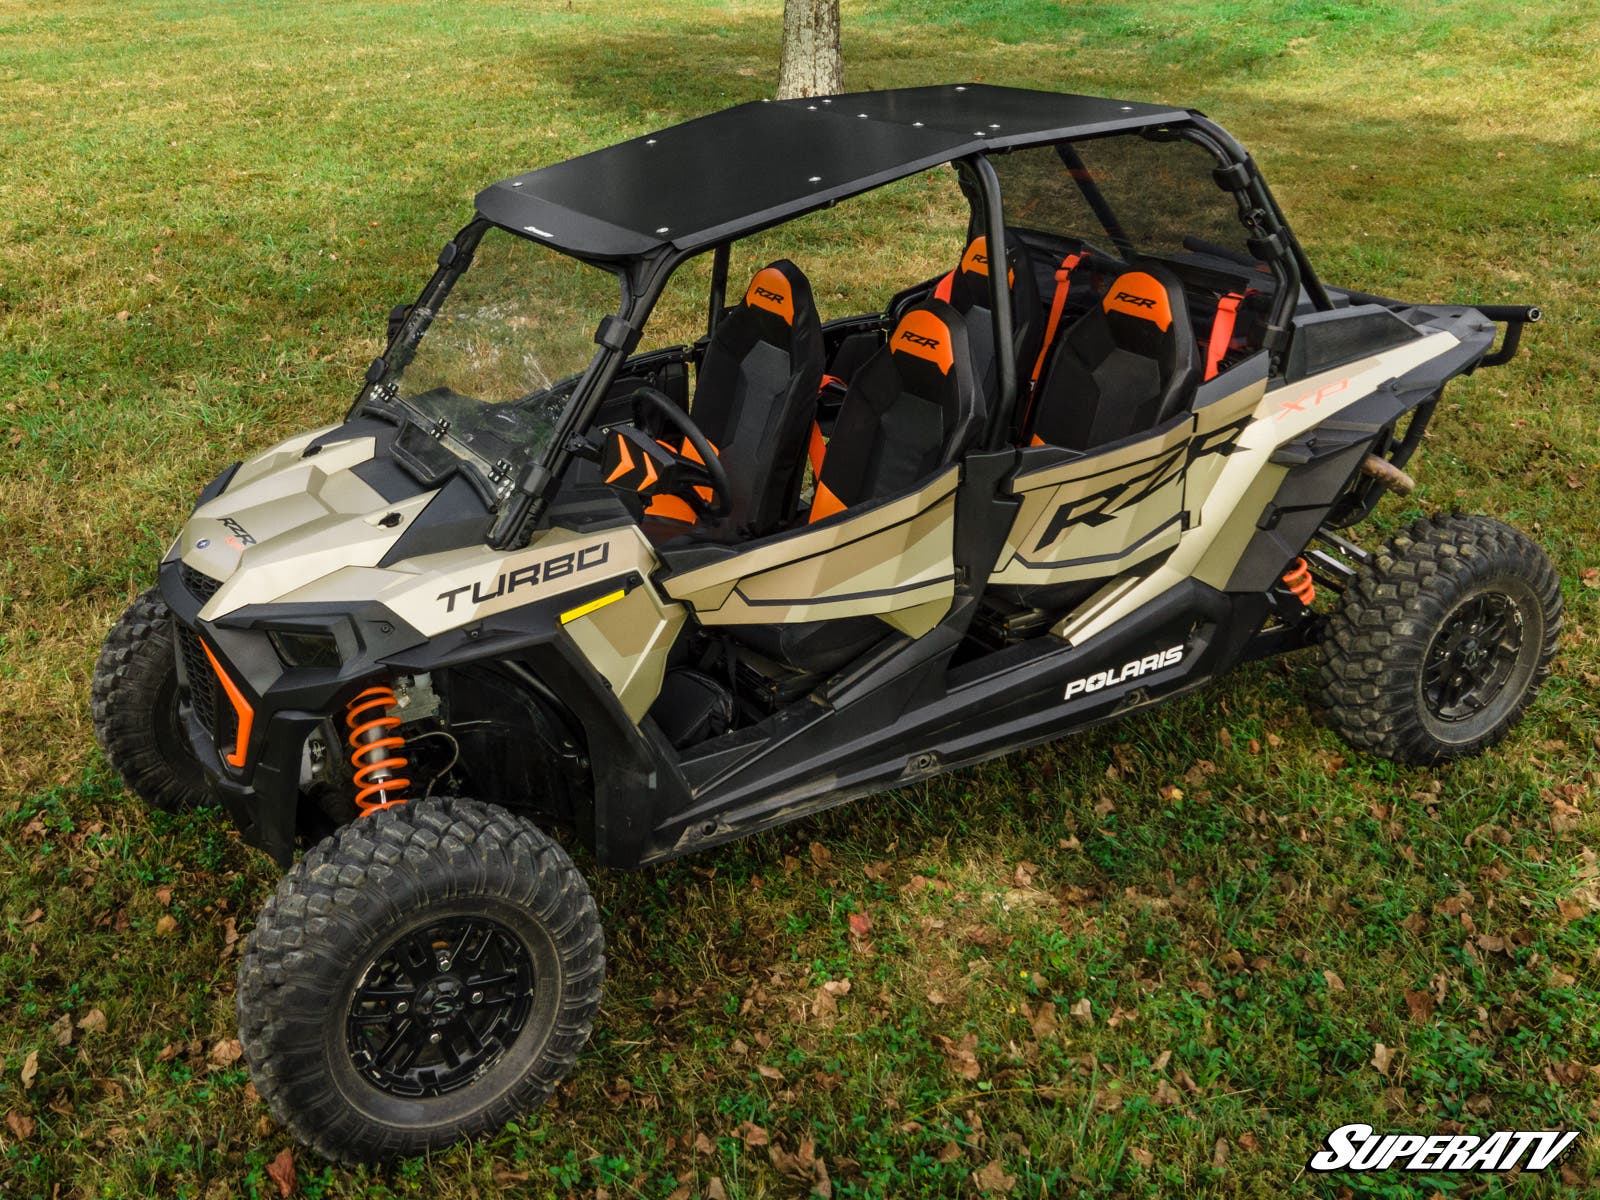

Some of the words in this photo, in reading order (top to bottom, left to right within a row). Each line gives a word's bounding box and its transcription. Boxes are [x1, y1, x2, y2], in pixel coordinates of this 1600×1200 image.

[971, 253, 988, 264] RZ
[754, 286, 784, 304] RZR
[1114, 291, 1157, 309] RZR
[900, 330, 940, 350] RZR
[1275, 377, 1348, 421] XP
[1033, 414, 1257, 553] RZR
[215, 517, 257, 545] RZR
[436, 541, 610, 613] TURBO
[1063, 644, 1184, 700] POLARIS
